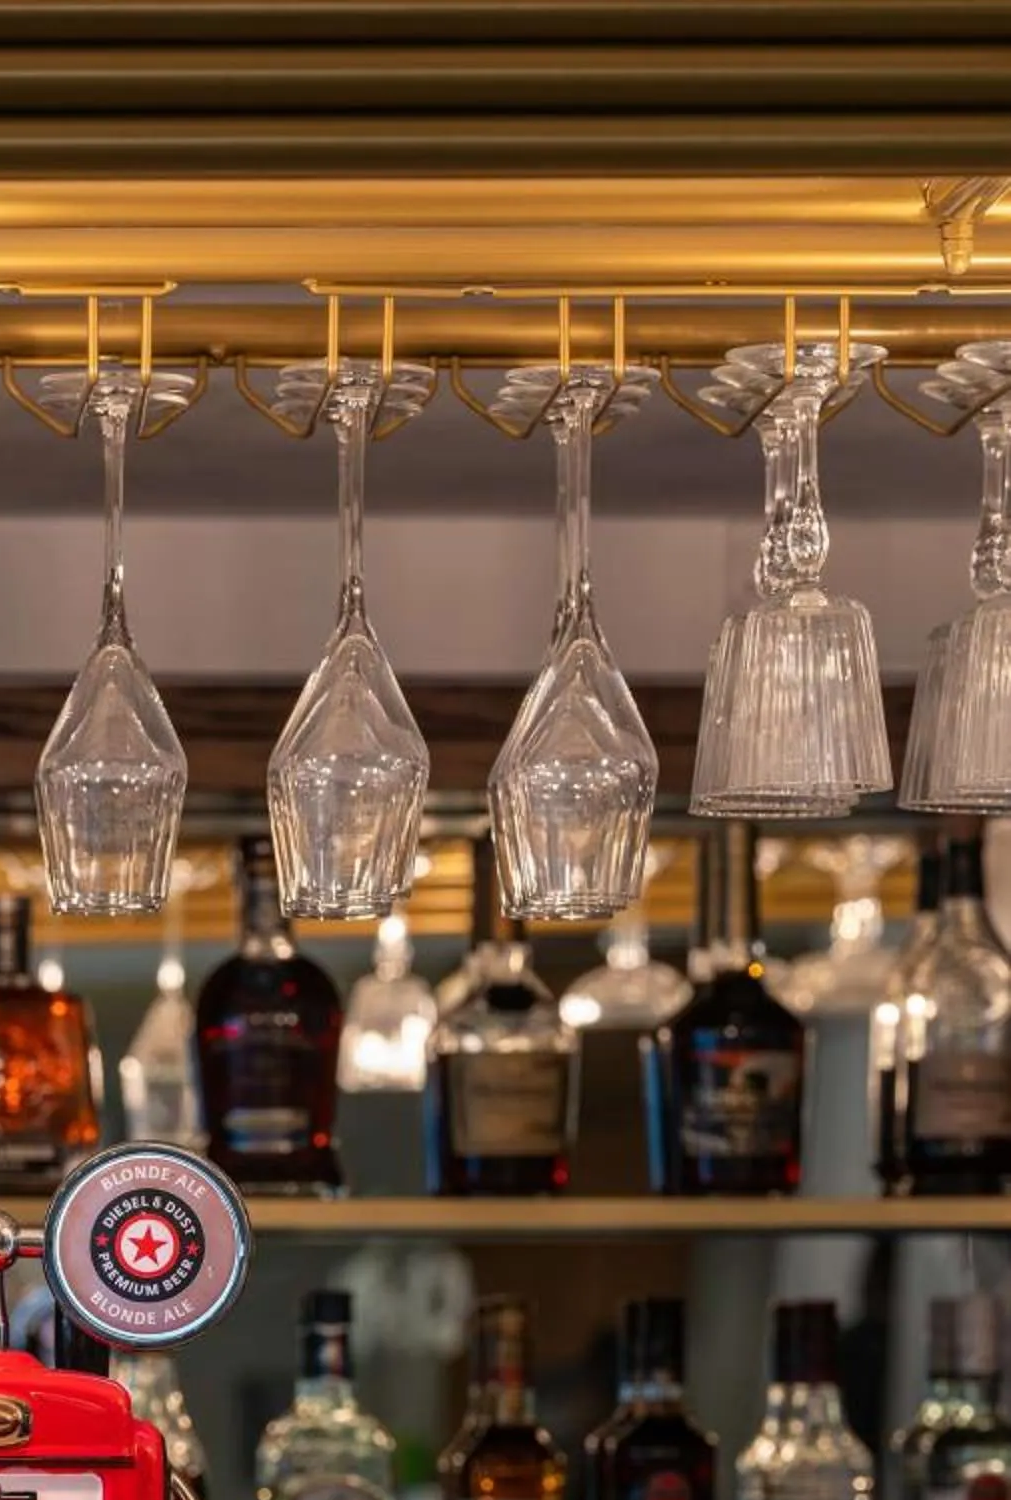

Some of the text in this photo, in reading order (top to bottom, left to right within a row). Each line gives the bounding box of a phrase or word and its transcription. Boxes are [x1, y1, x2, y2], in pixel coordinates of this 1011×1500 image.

[100, 1166, 206, 1199] BLONDE ALE
[102, 1196, 149, 1229] DIESEL
[164, 1201, 196, 1235] DUST
[98, 1252, 194, 1296] PREMIUM BEER
[90, 1291, 195, 1325] BLONDE ALE
